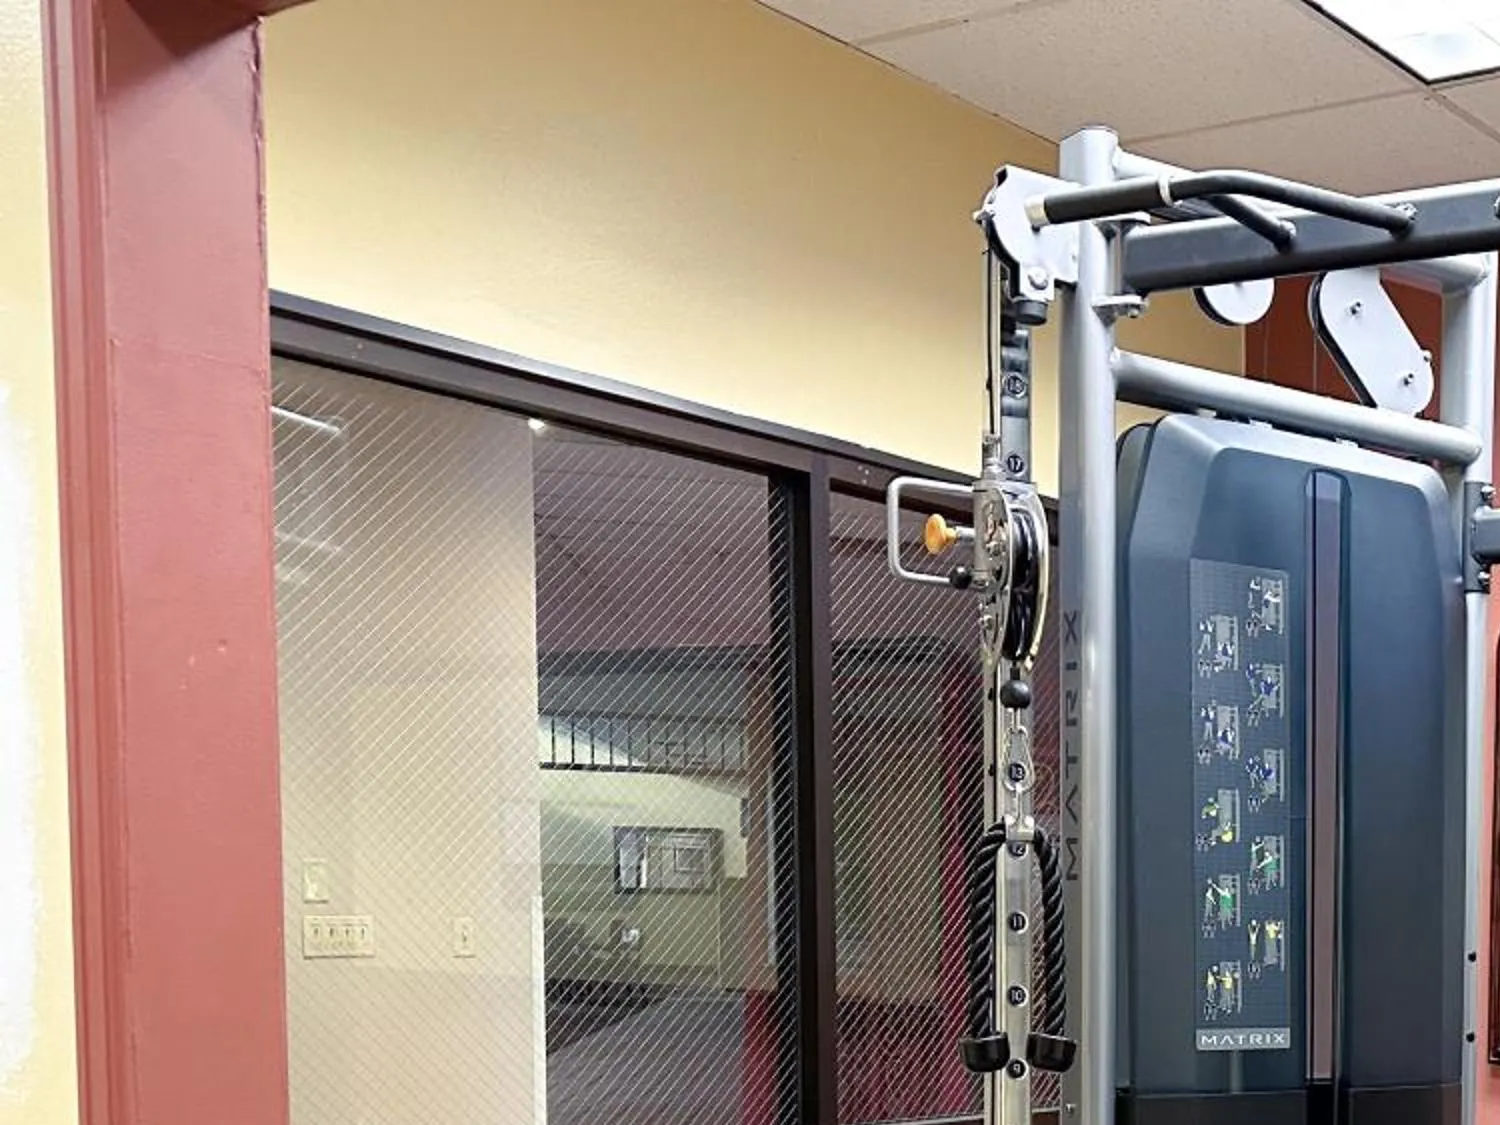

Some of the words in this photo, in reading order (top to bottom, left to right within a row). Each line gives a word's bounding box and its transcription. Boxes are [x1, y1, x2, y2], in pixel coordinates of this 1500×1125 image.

[1064, 610, 1078, 880] MATRIX
[1013, 913, 1023, 927] 11
[1011, 989, 1023, 1002] 10
[1200, 1033, 1285, 1046] MATRIX
[1013, 1063, 1021, 1075] 9
